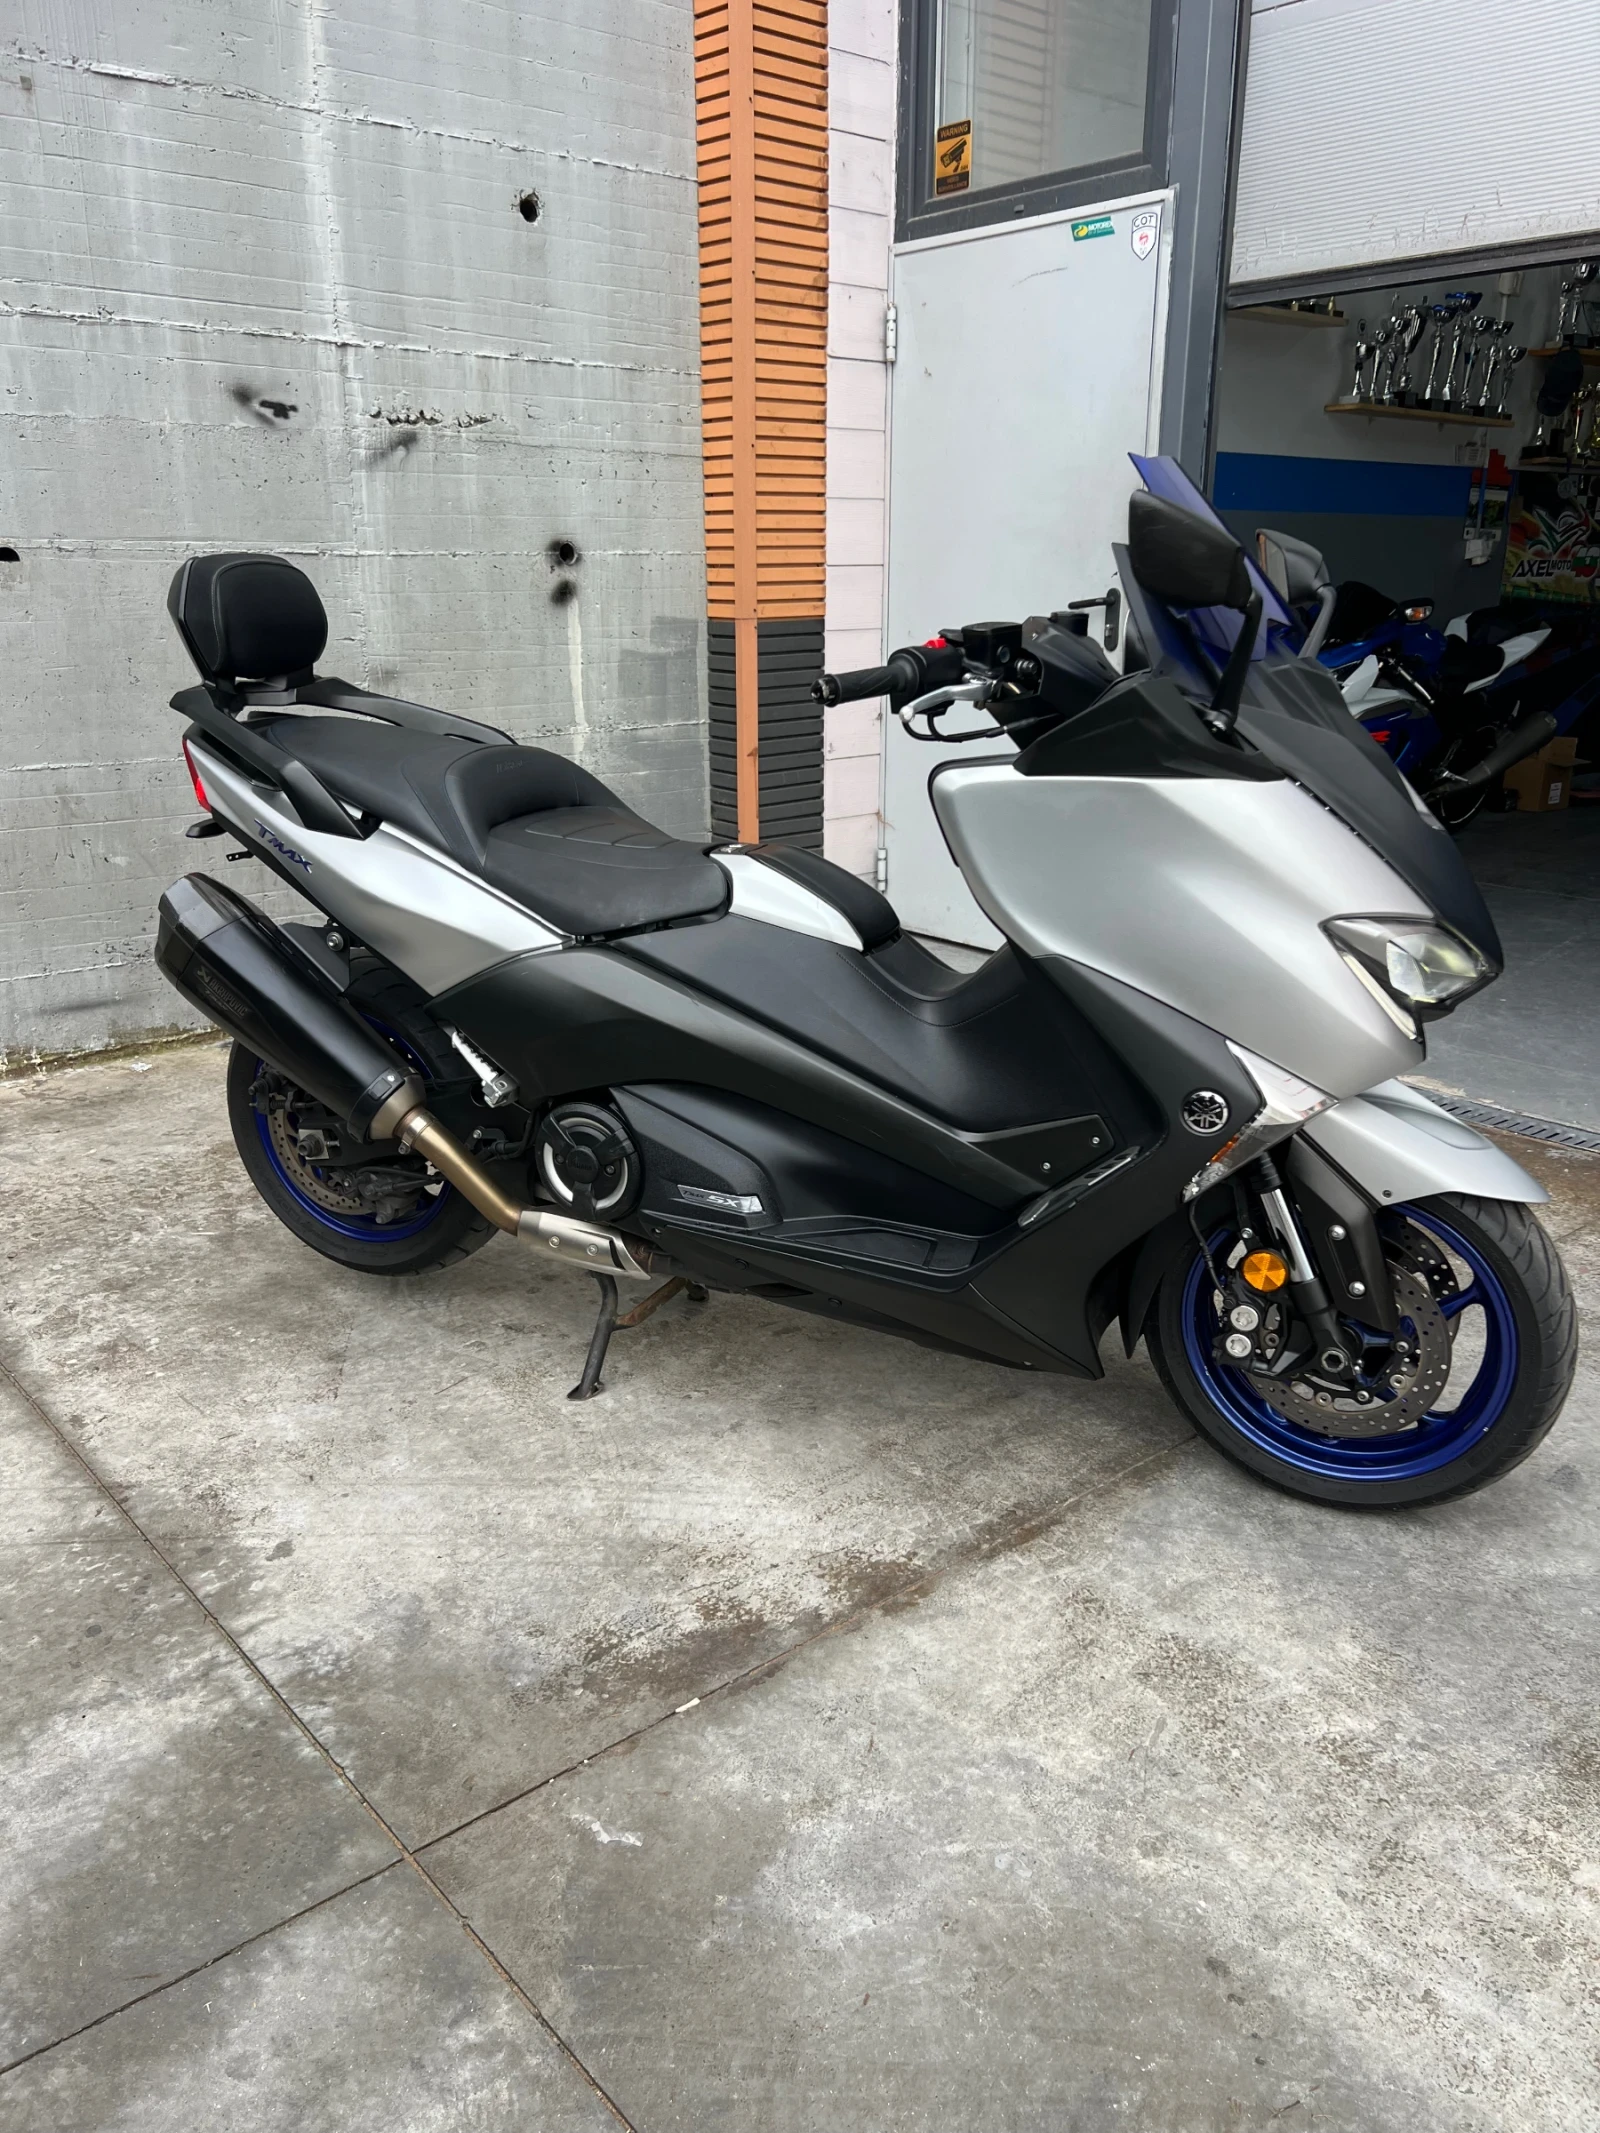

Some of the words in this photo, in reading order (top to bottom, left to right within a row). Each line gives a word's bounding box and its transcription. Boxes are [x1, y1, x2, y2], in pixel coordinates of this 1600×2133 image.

[940, 124, 968, 138] WARNING
[1133, 215, 1154, 228] COT
[1511, 559, 1555, 577] AXEL
[1551, 559, 1572, 571] MOTO
